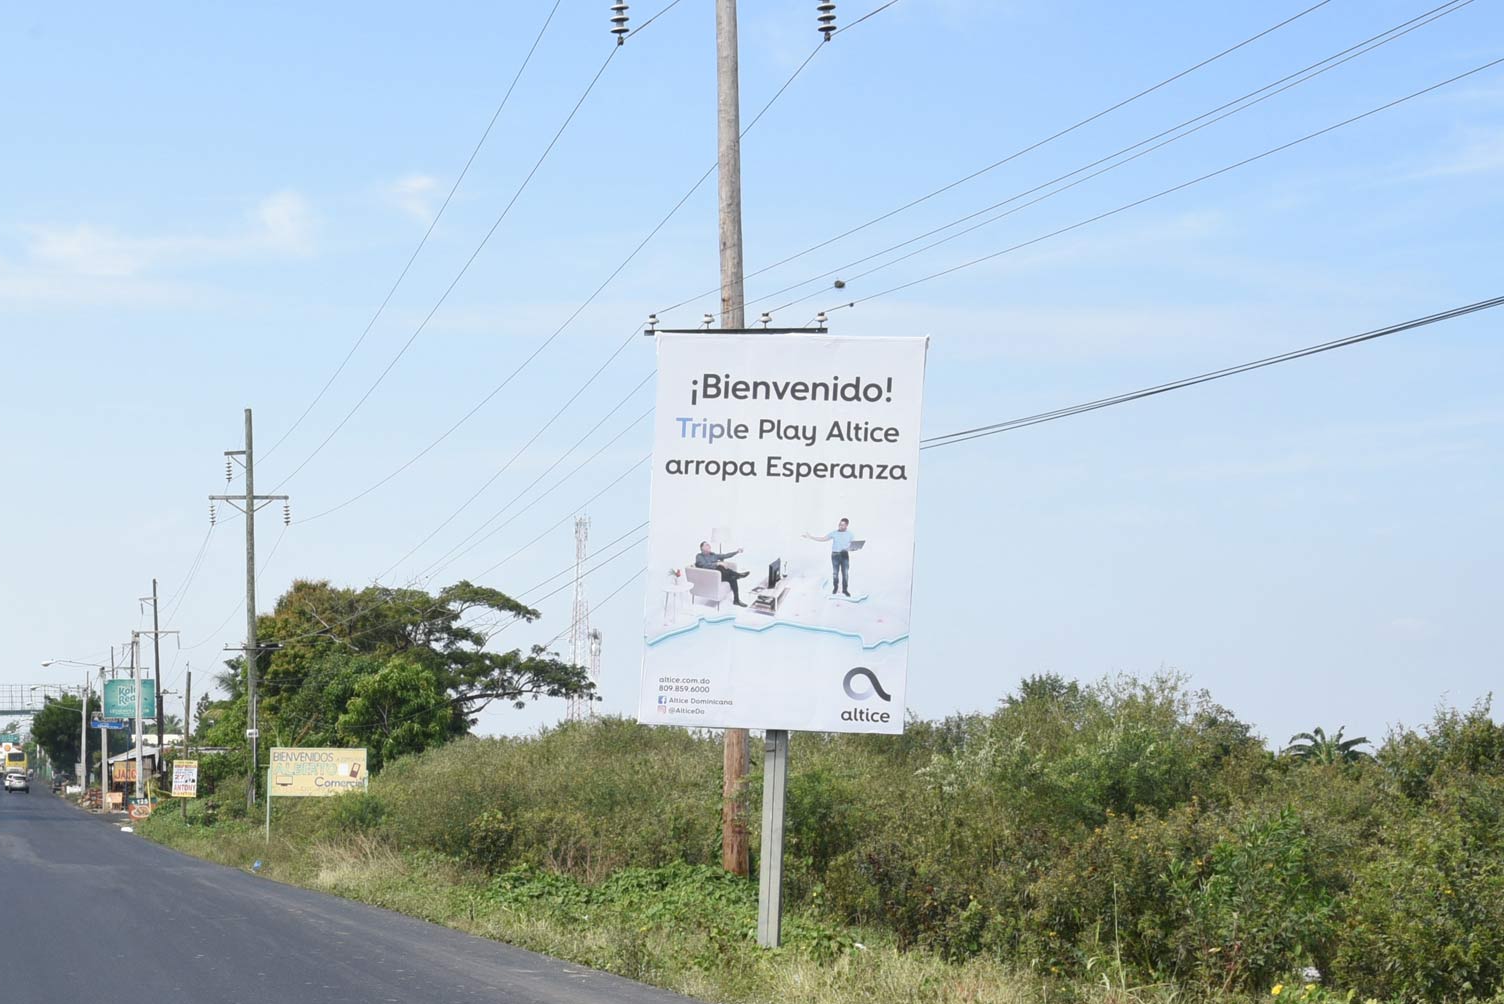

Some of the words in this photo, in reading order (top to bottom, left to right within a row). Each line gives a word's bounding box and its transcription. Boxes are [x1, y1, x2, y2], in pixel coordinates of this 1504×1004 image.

[691, 373, 893, 405] ¡Bienvenido!
[676, 417, 749, 444] Triple
[759, 419, 817, 447] Play
[826, 420, 900, 443] Altice
[665, 457, 757, 481] arropa
[766, 456, 908, 483] Esperanza
[658, 675, 711, 685] altice.com.do
[658, 684, 710, 694] 809.859.6000
[668, 696, 689, 705] Altice
[690, 697, 734, 706] Dominicana
[840, 707, 891, 724] altice
[273, 752, 334, 763] BIENVENIDOS
